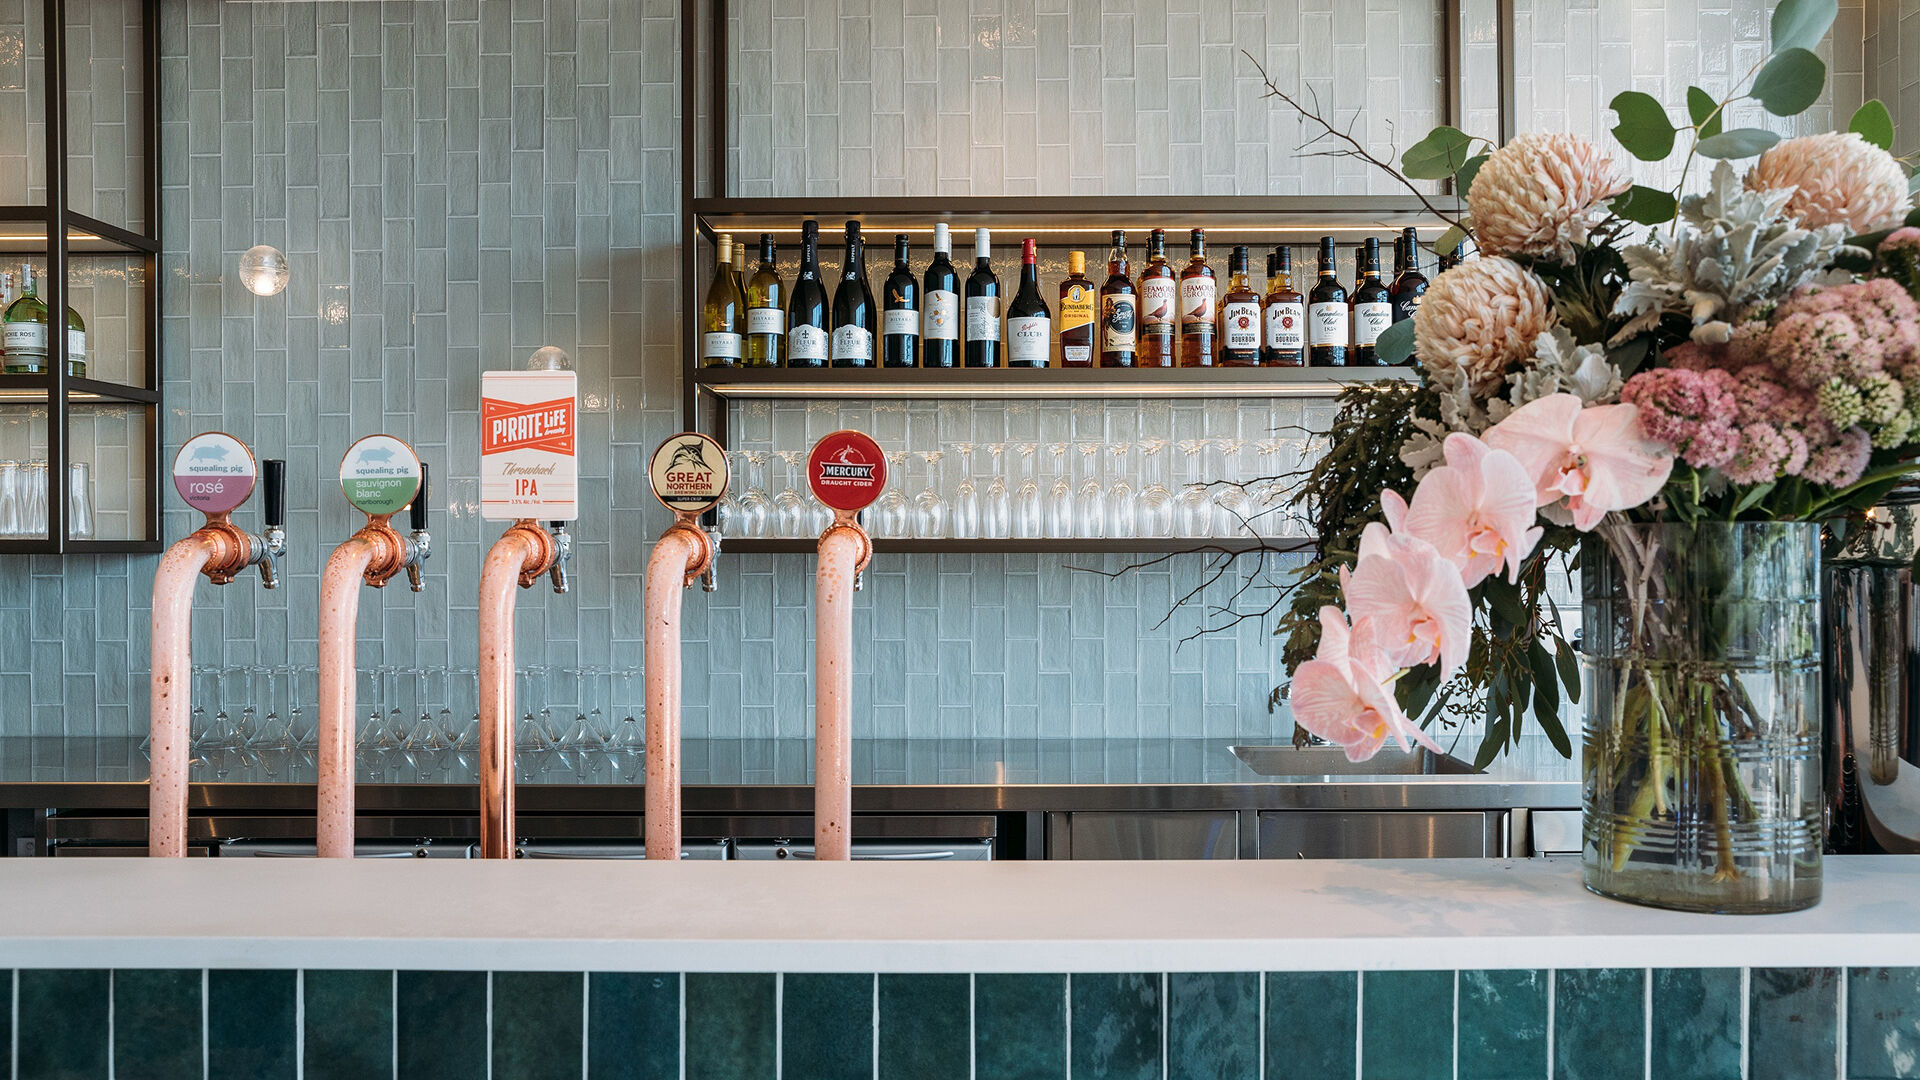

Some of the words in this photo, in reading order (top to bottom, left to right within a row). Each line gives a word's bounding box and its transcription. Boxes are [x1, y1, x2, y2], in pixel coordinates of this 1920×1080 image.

[1229, 309, 1241, 320] JIM
[1273, 309, 1284, 320] JIM
[189, 465, 228, 473] squealing
[230, 465, 243, 473] pig
[355, 467, 394, 475] squealing
[396, 466, 409, 474] pig
[502, 462, 556, 476] Throwback
[826, 465, 869, 477] MERCURY
[666, 472, 712, 483] GREAT
[190, 479, 224, 494] rosé
[355, 480, 402, 489] sauvignon
[515, 479, 538, 496] IPA
[356, 489, 381, 498] blanc
